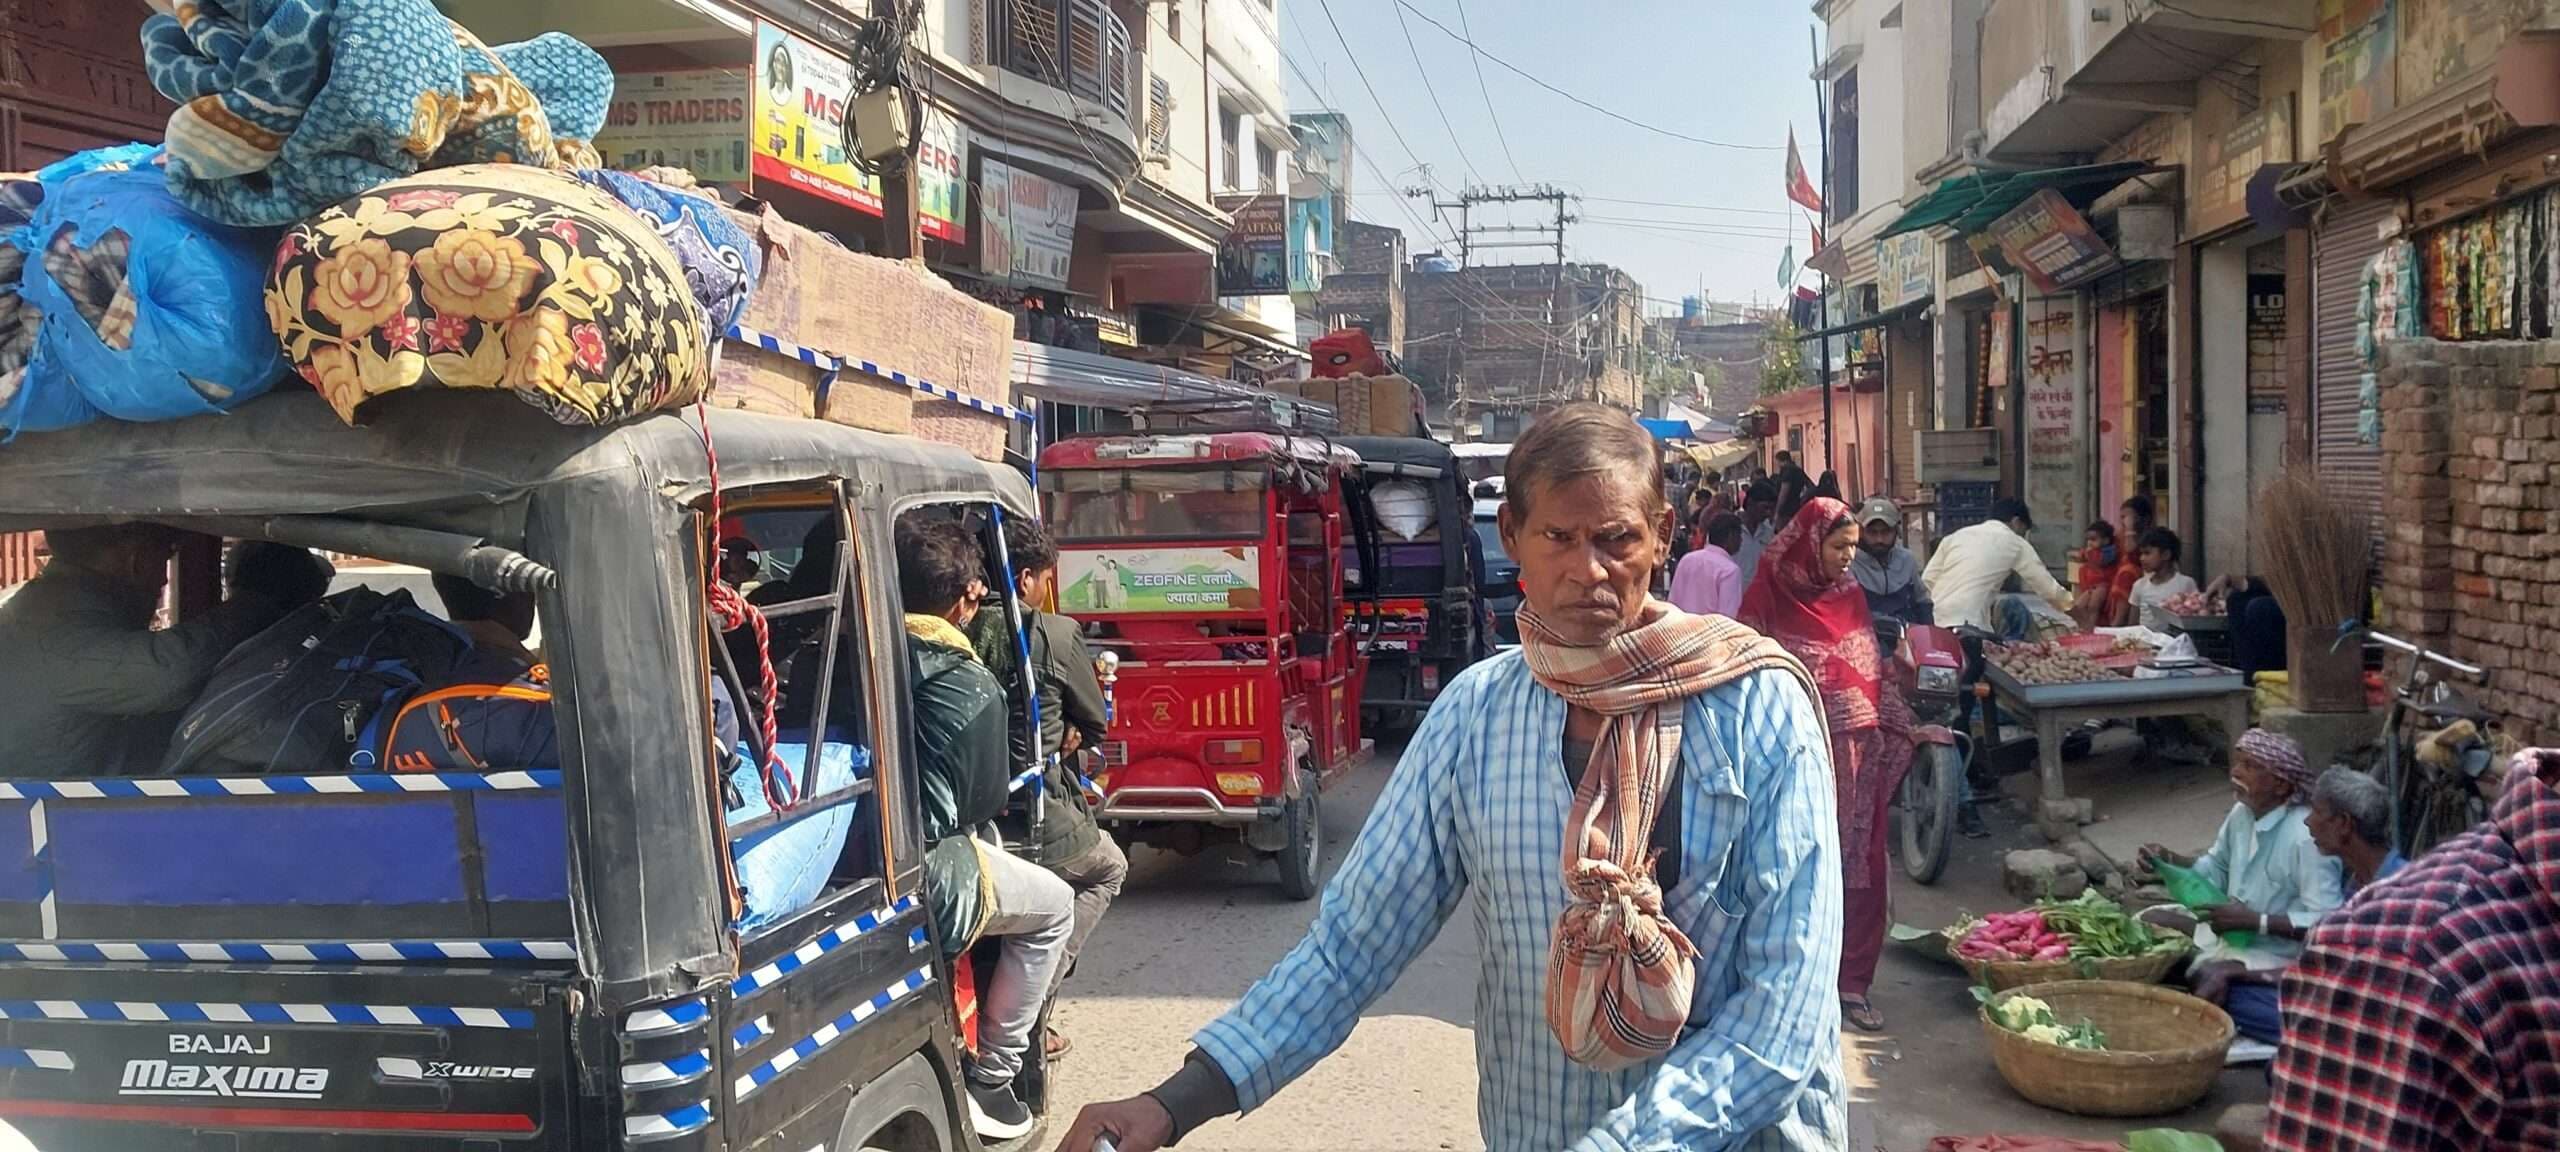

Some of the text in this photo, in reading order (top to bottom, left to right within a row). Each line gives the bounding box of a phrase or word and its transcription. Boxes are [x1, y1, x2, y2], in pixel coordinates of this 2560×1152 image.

[608, 97, 743, 126] MS TRADERS
[803, 86, 843, 127] MS
[1233, 222, 1282, 233] ZAFFAR
[2254, 294, 2284, 309] LO
[1133, 574, 1197, 587] ZEOFINE
[169, 1034, 271, 1054] BAJAJ
[119, 1058, 329, 1098] Maxima
